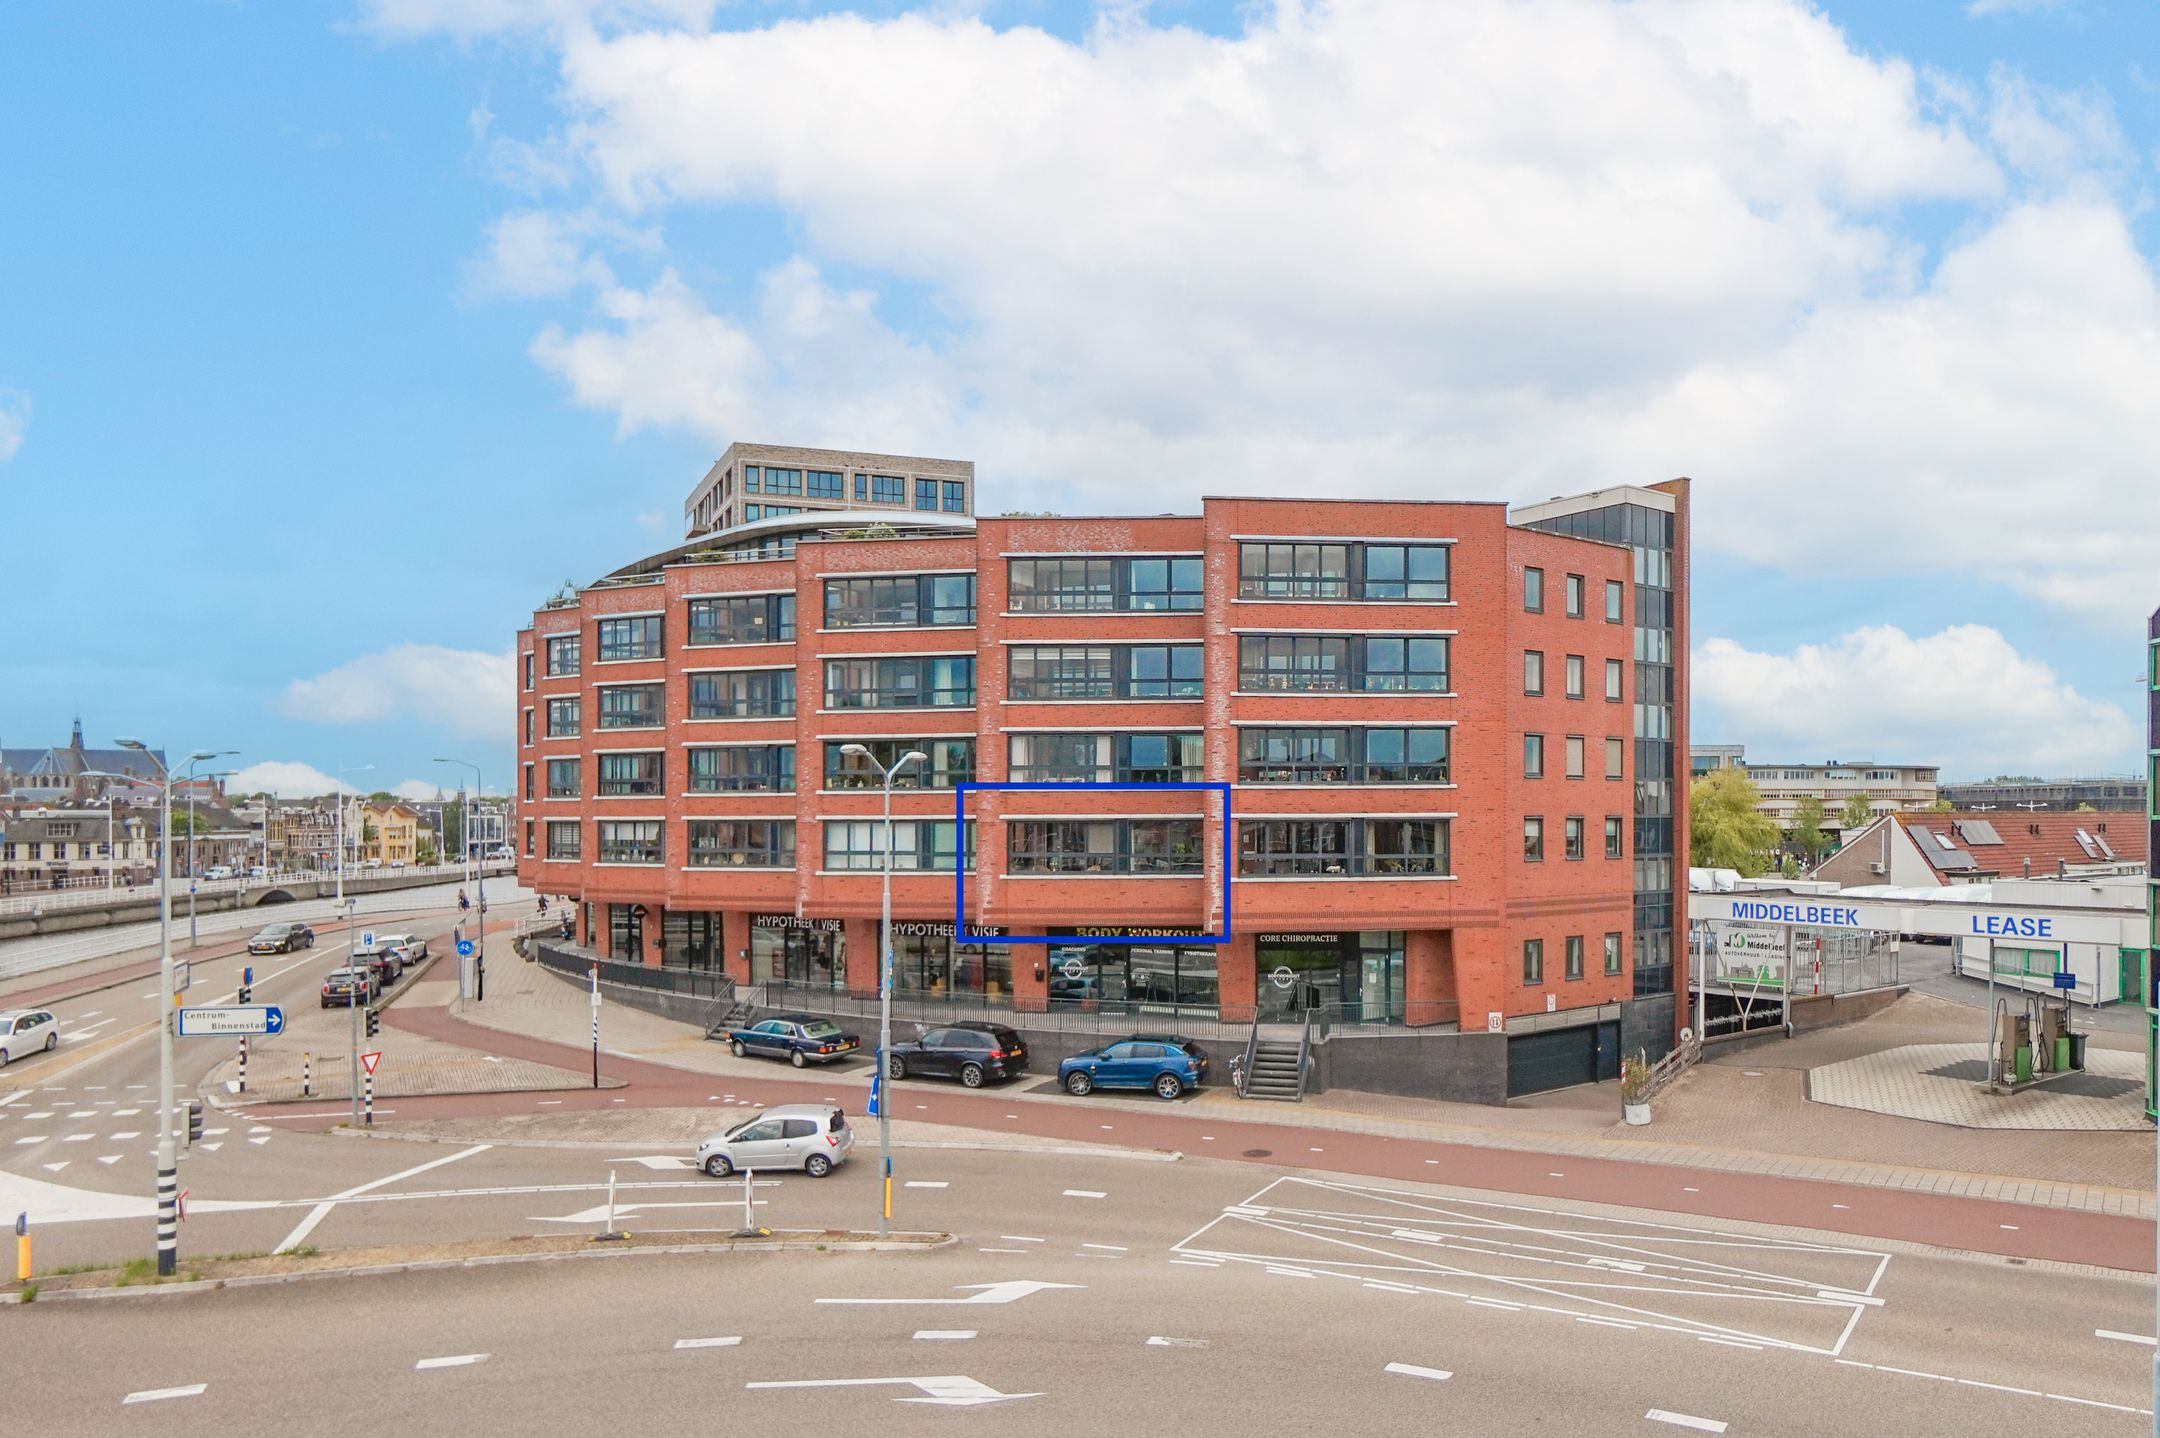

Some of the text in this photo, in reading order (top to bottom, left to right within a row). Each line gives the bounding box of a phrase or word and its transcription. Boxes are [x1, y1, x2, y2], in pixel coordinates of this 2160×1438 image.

[1732, 902, 1858, 926] MIDDELBEEK
[757, 915, 841, 931] HYPOTHEEK VISIE
[890, 922, 957, 937] HYPOTHEE
[1972, 915, 2052, 937] LEASE
[1260, 934, 1339, 943] CORE CHIROPRACTIE
[184, 1011, 230, 1020] Centrum-
[211, 1022, 266, 1031] Binnenstad
